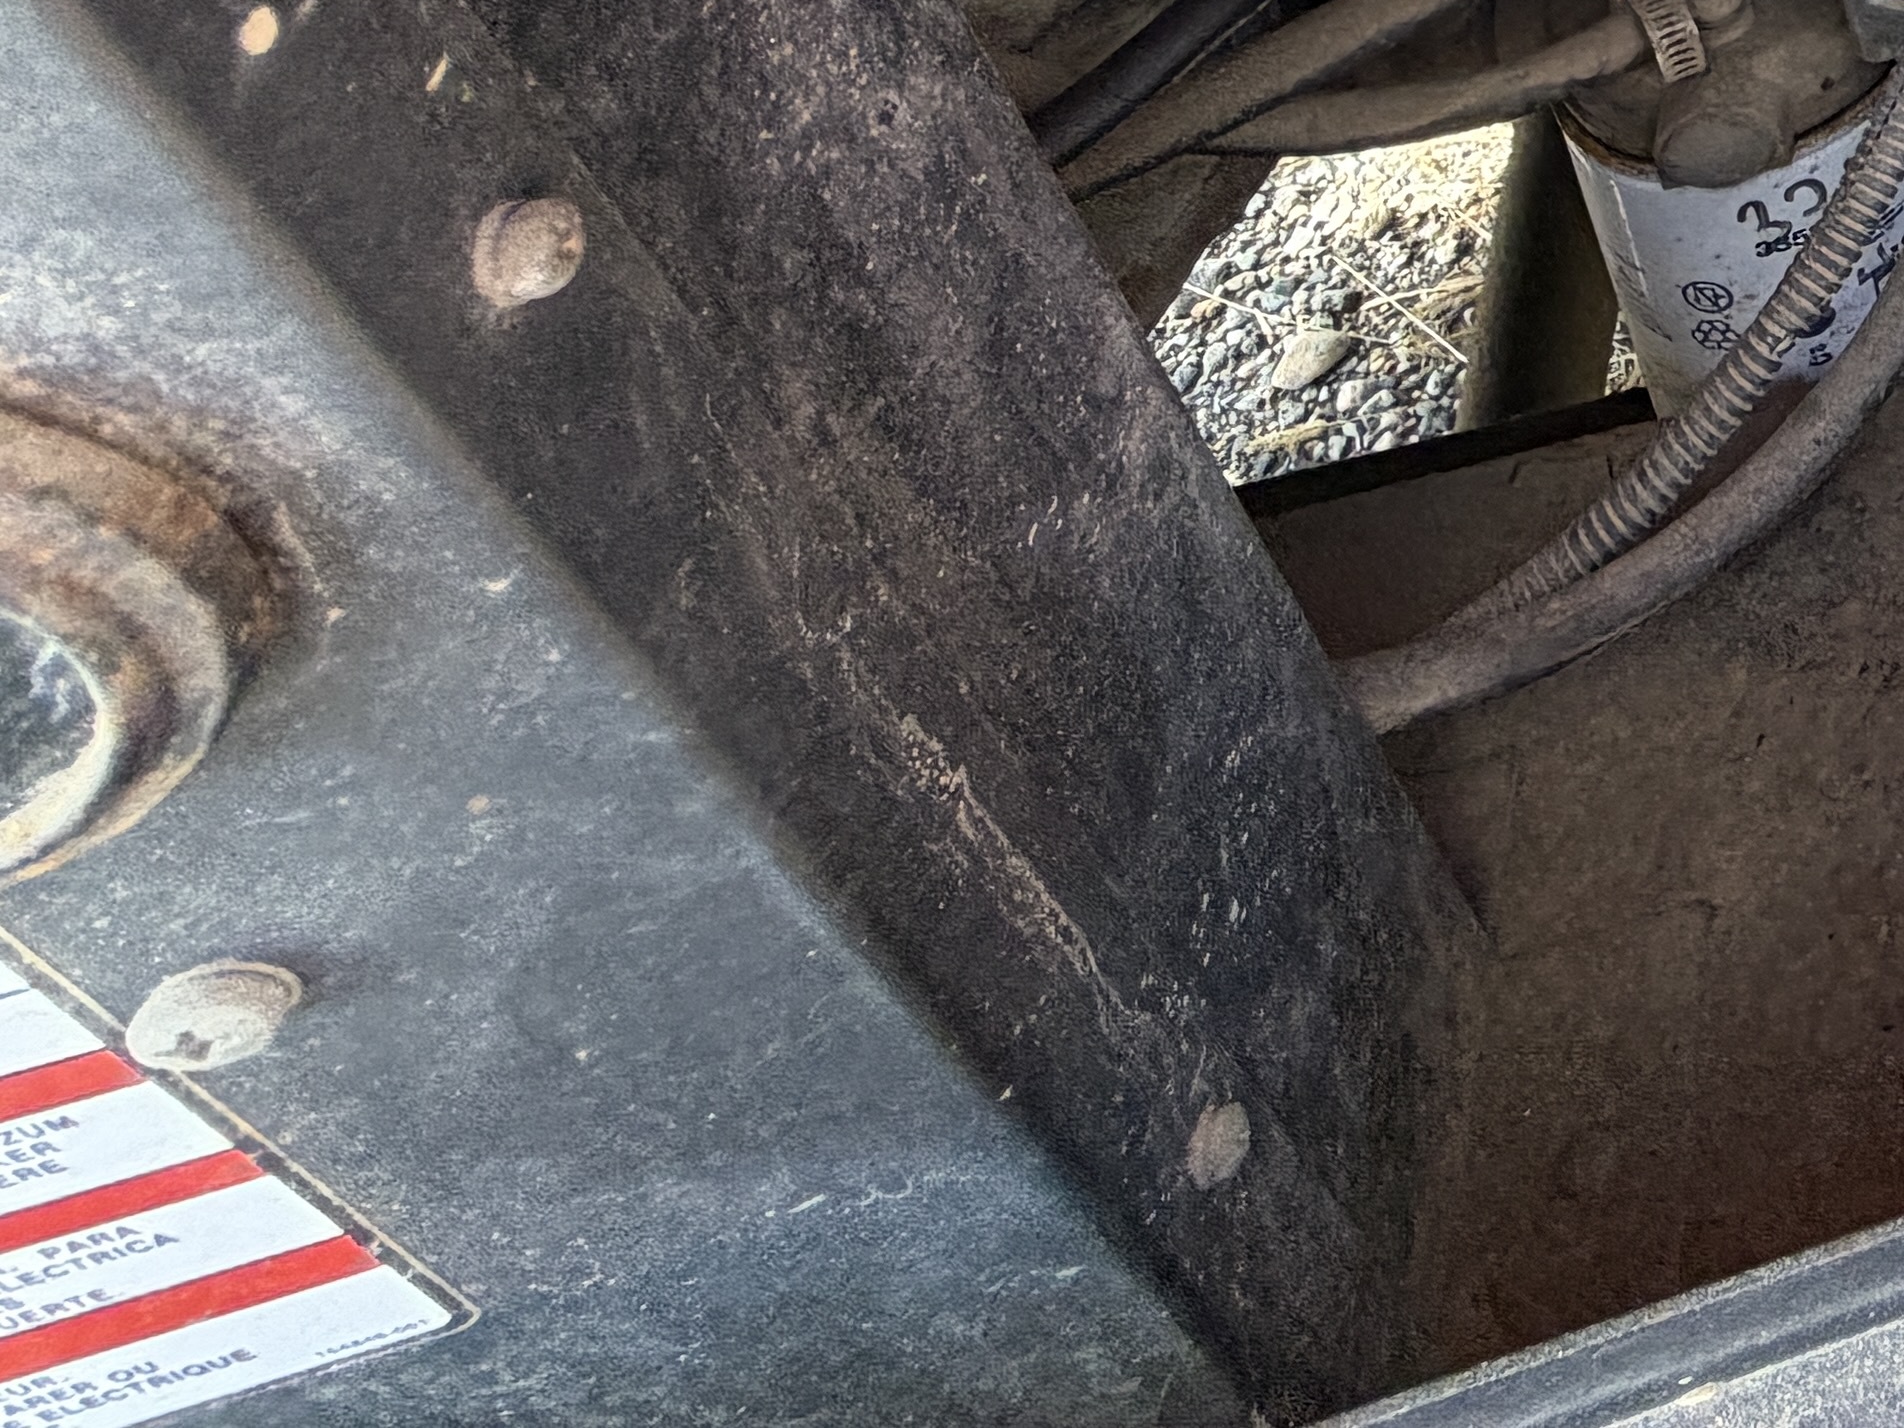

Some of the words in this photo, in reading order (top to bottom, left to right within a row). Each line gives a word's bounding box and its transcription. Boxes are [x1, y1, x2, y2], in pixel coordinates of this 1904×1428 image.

[0, 1116, 79, 1146] ZUM
[37, 1225, 142, 1260] PARA
[35, 1346, 258, 1422] ELECTRIQUE
[106, 1360, 160, 1383] OU
